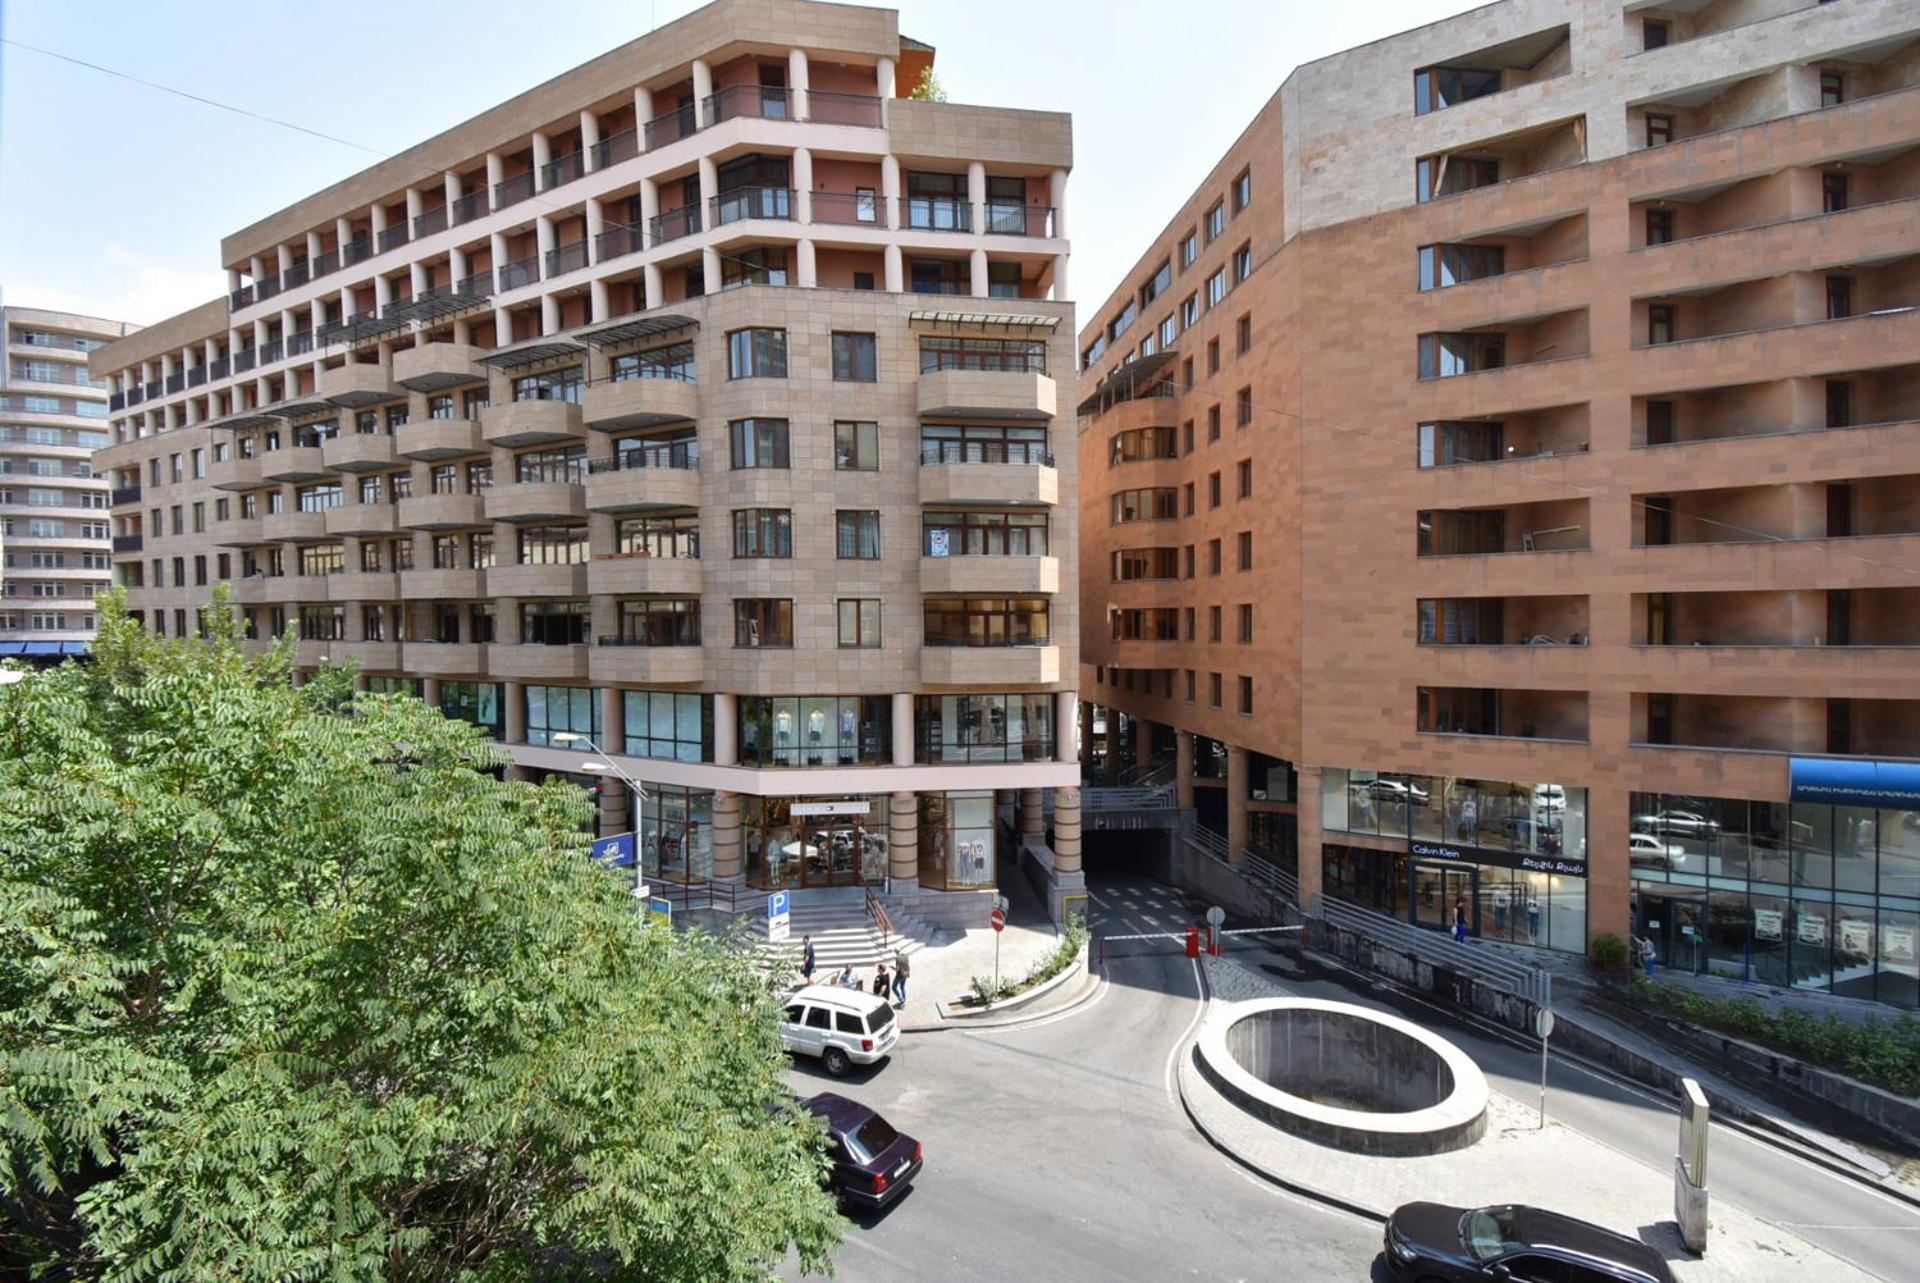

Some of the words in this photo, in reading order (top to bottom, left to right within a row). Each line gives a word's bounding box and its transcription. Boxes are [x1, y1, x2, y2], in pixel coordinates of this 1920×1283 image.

[1412, 844, 1439, 856] Calvin
[1439, 848, 1460, 858] Klein
[773, 894, 785, 916] P
